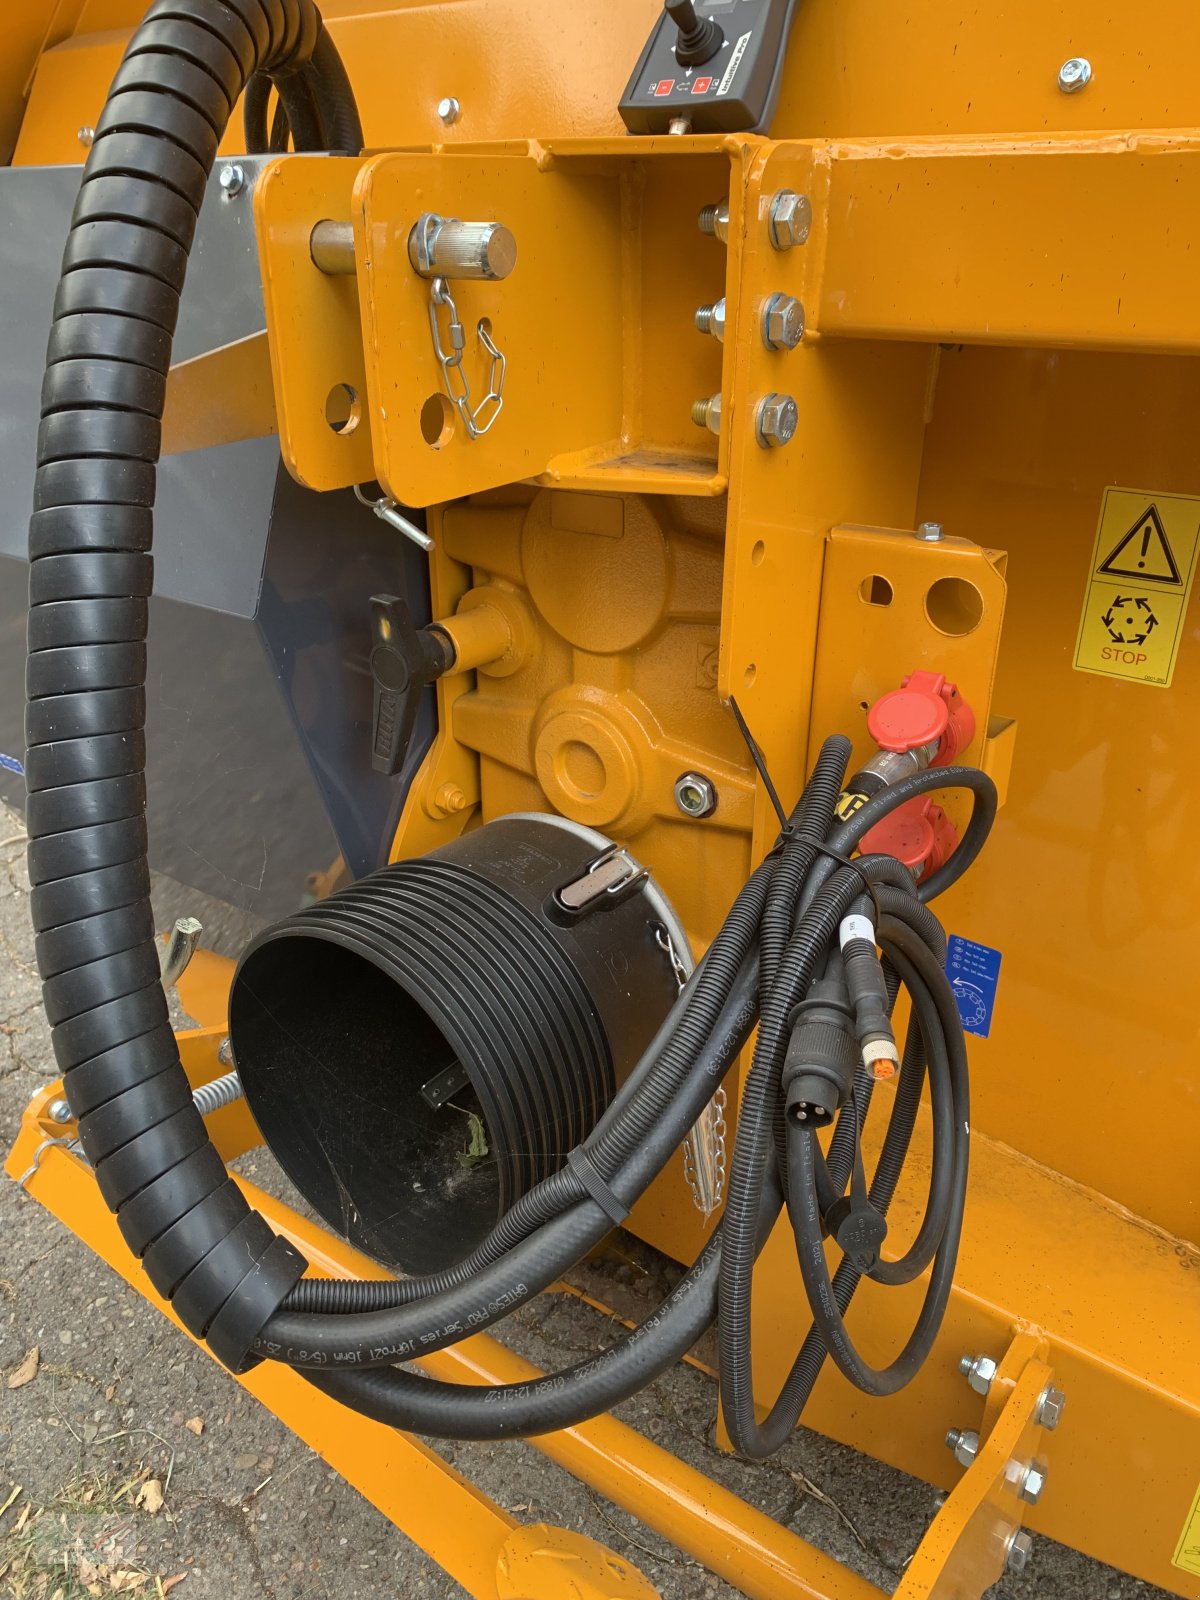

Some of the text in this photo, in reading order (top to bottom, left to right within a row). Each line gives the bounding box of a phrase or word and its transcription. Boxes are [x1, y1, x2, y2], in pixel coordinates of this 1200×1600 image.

[721, 37, 748, 92] Intuitive Pro
[1100, 646, 1147, 665] STOP
[671, 1280, 694, 1303] Made
[627, 1316, 661, 1347] Poland
[333, 1350, 362, 1363] 16mm
